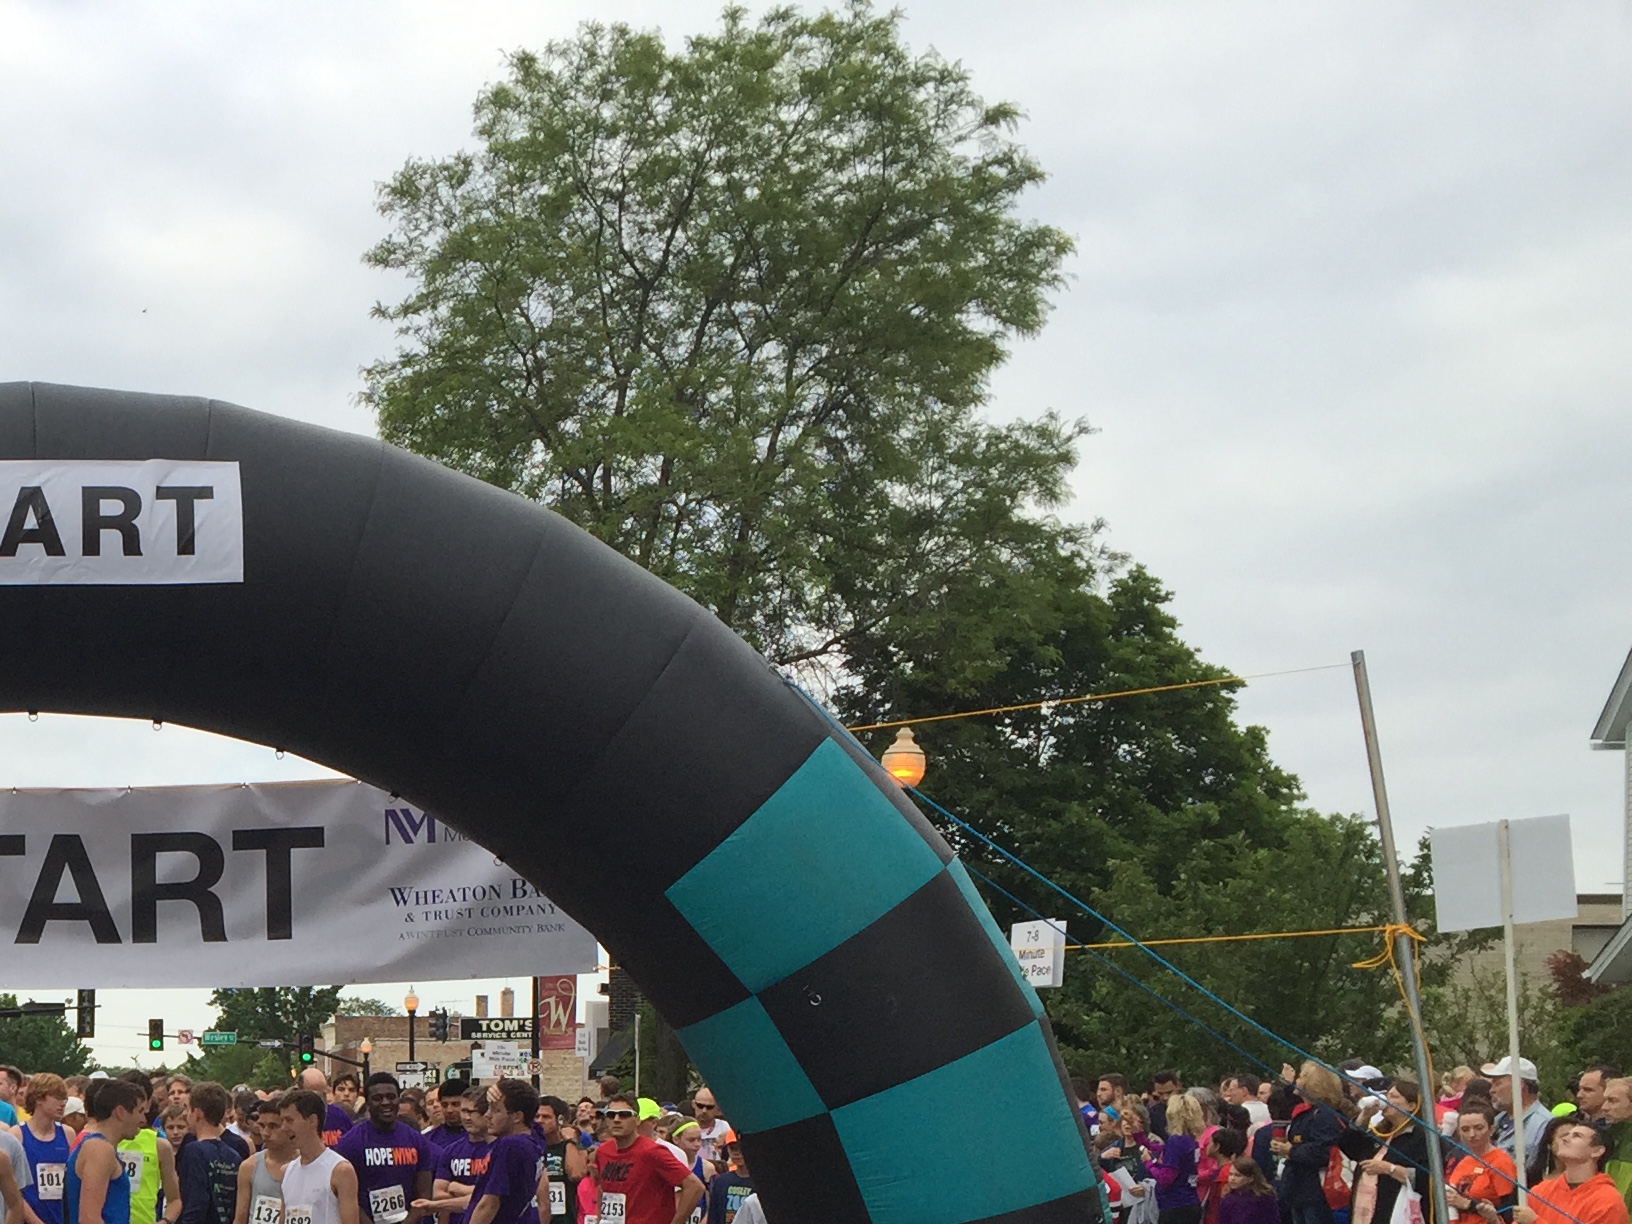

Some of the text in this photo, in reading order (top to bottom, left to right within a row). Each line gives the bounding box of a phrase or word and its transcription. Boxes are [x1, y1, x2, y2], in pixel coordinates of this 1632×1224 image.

[388, 878, 546, 907] WHEATON BA
[422, 908, 475, 922] TRUST
[480, 903, 556, 919] COMPANY
[537, 923, 565, 933] BANK
[478, 1020, 532, 1031] TOM'S
[39, 1173, 65, 1187] 101
[602, 1162, 634, 1182] NIKE
[372, 1194, 404, 1214] 2266
[601, 1202, 624, 1216] 2153
